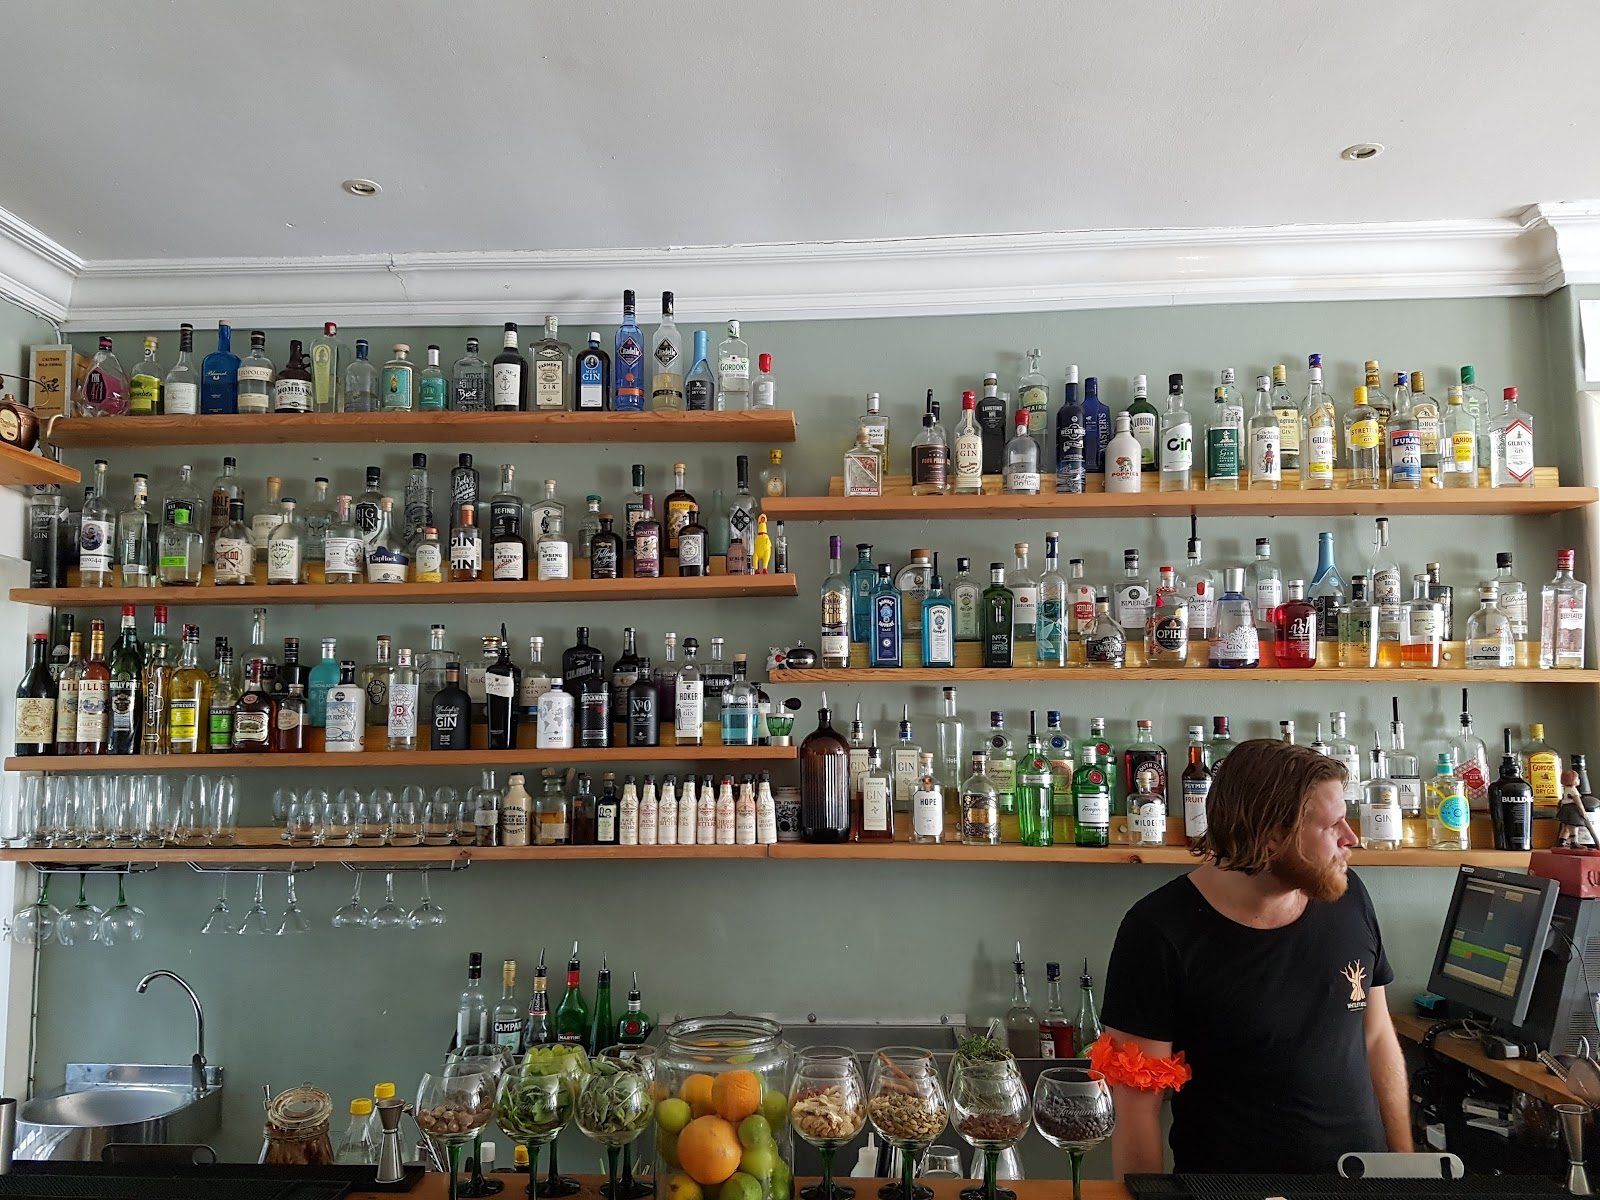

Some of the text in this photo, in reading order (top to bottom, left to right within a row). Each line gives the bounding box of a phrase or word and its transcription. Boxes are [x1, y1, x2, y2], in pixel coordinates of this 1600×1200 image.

[582, 373, 601, 382] GIN
[960, 442, 977, 450] DRY
[435, 717, 457, 728] GIN
[851, 761, 868, 772] GIN
[897, 762, 915, 772] GIN
[866, 789, 883, 800] GIN
[919, 798, 937, 806] HOPE
[1185, 796, 1204, 804] FRUIT
[1374, 814, 1391, 823] GIN
